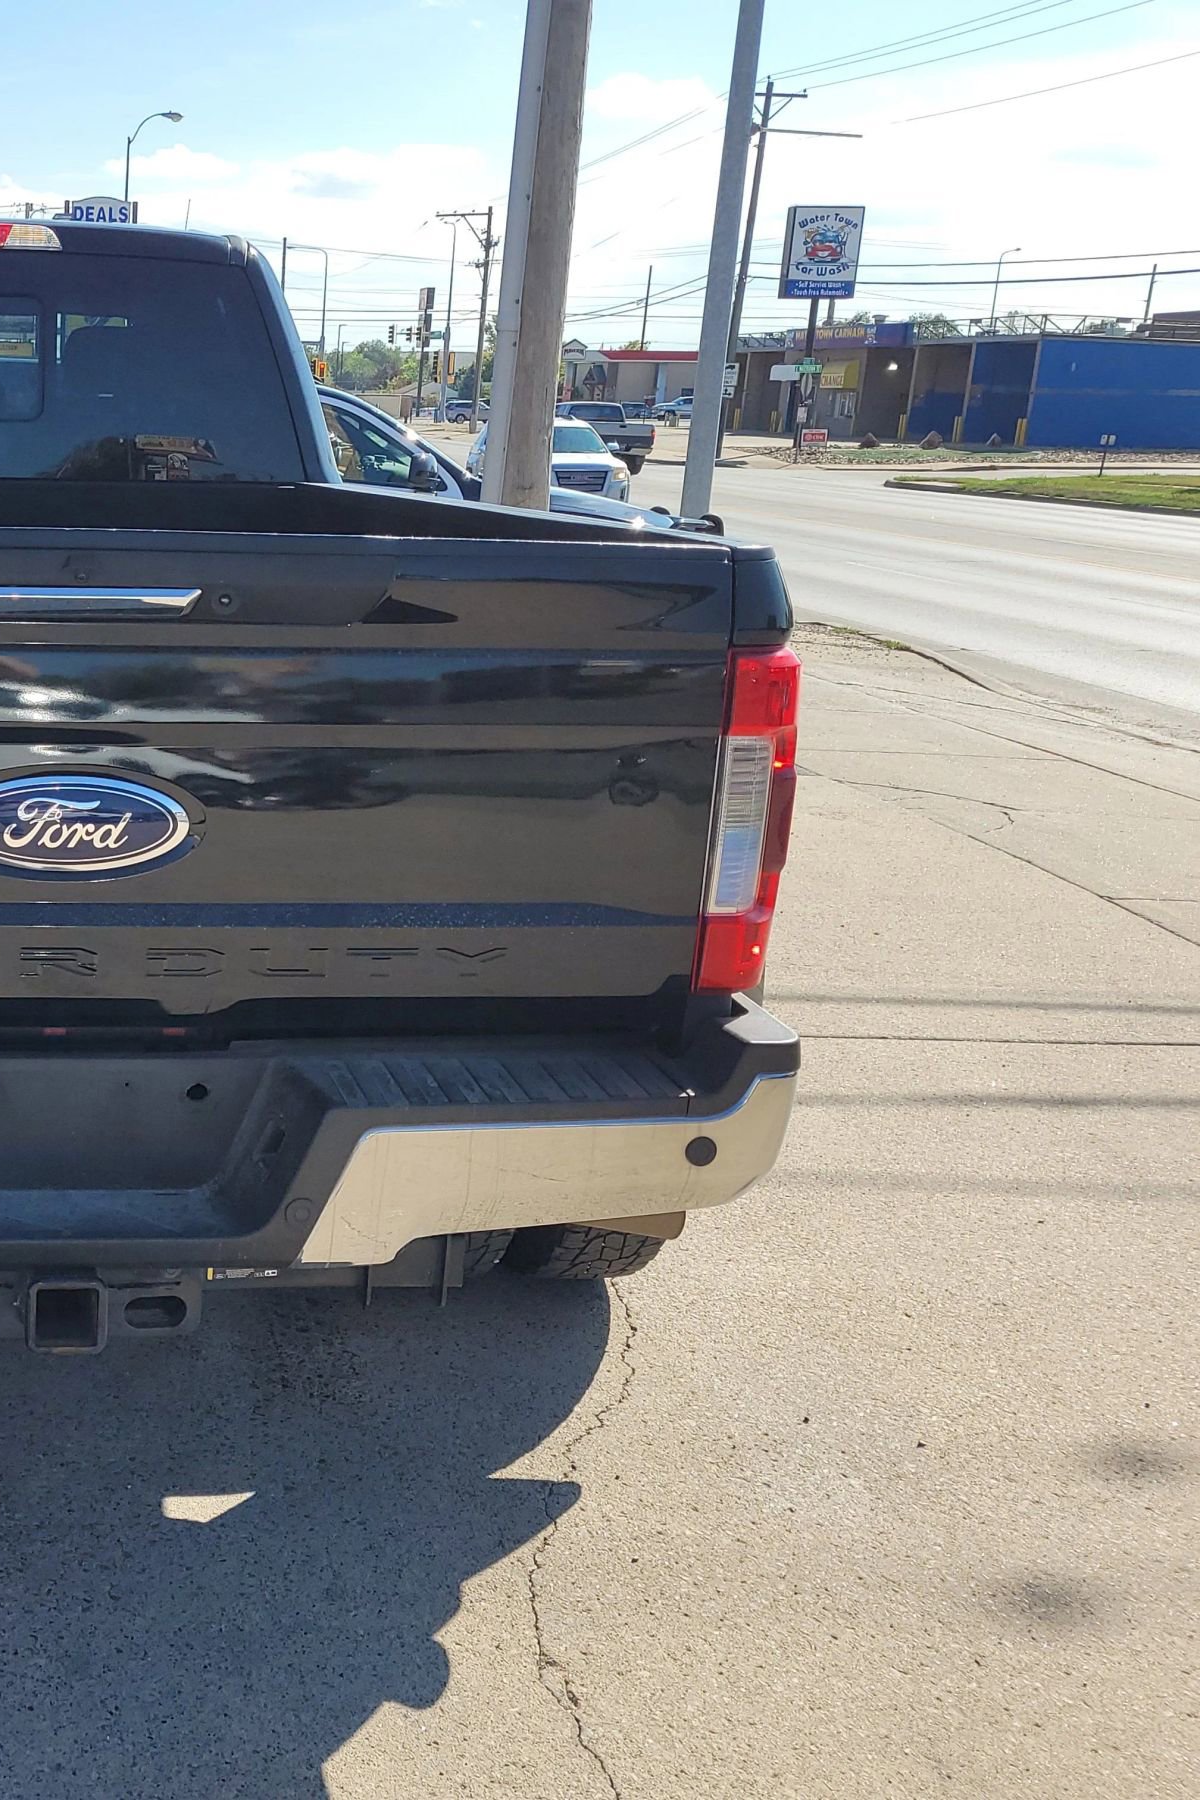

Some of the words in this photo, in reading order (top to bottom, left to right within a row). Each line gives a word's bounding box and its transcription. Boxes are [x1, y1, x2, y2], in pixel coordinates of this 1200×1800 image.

[74, 206, 128, 223] DEALS
[798, 213, 830, 229] Water
[834, 213, 858, 230] Town
[795, 262, 813, 275] Car
[816, 262, 850, 277] Wash
[816, 328, 833, 339] TOWN
[834, 327, 865, 338] CARWASH
[821, 375, 844, 386] CHANGE
[3, 797, 133, 849] Ford
[146, 946, 508, 977] DUTY
